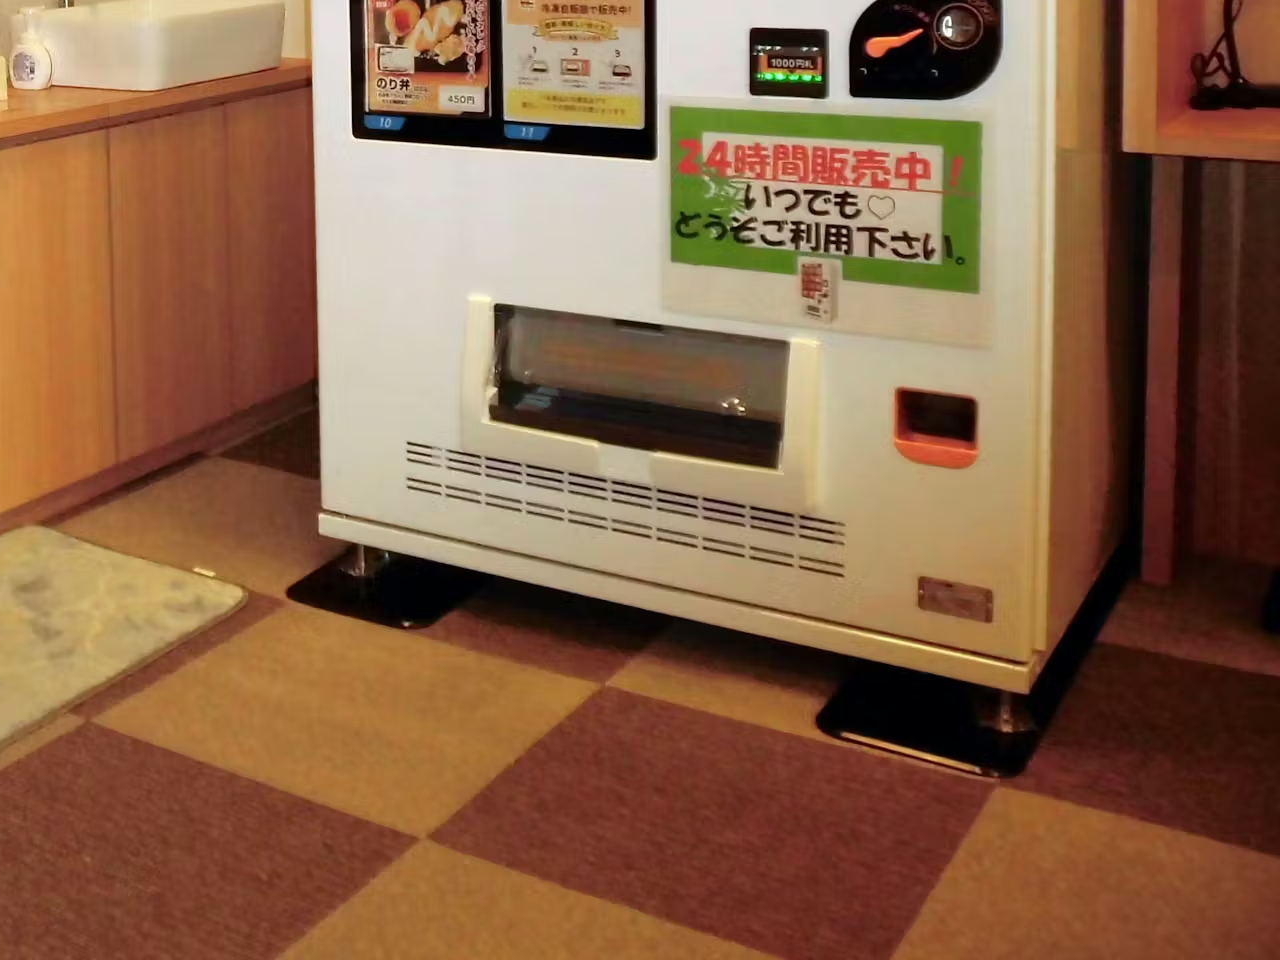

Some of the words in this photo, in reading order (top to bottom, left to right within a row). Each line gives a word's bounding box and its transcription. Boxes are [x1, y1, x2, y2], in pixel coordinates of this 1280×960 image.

[572, 48, 578, 56] 2
[615, 50, 621, 58] 3
[771, 58, 815, 68] 1000円札
[376, 78, 410, 91] のり弁
[448, 95, 475, 105] 450円
[380, 117, 392, 128] 10
[521, 127, 534, 138] 11
[744, 184, 862, 220] いつでも
[675, 211, 966, 266] どうぞご利用下さい。
